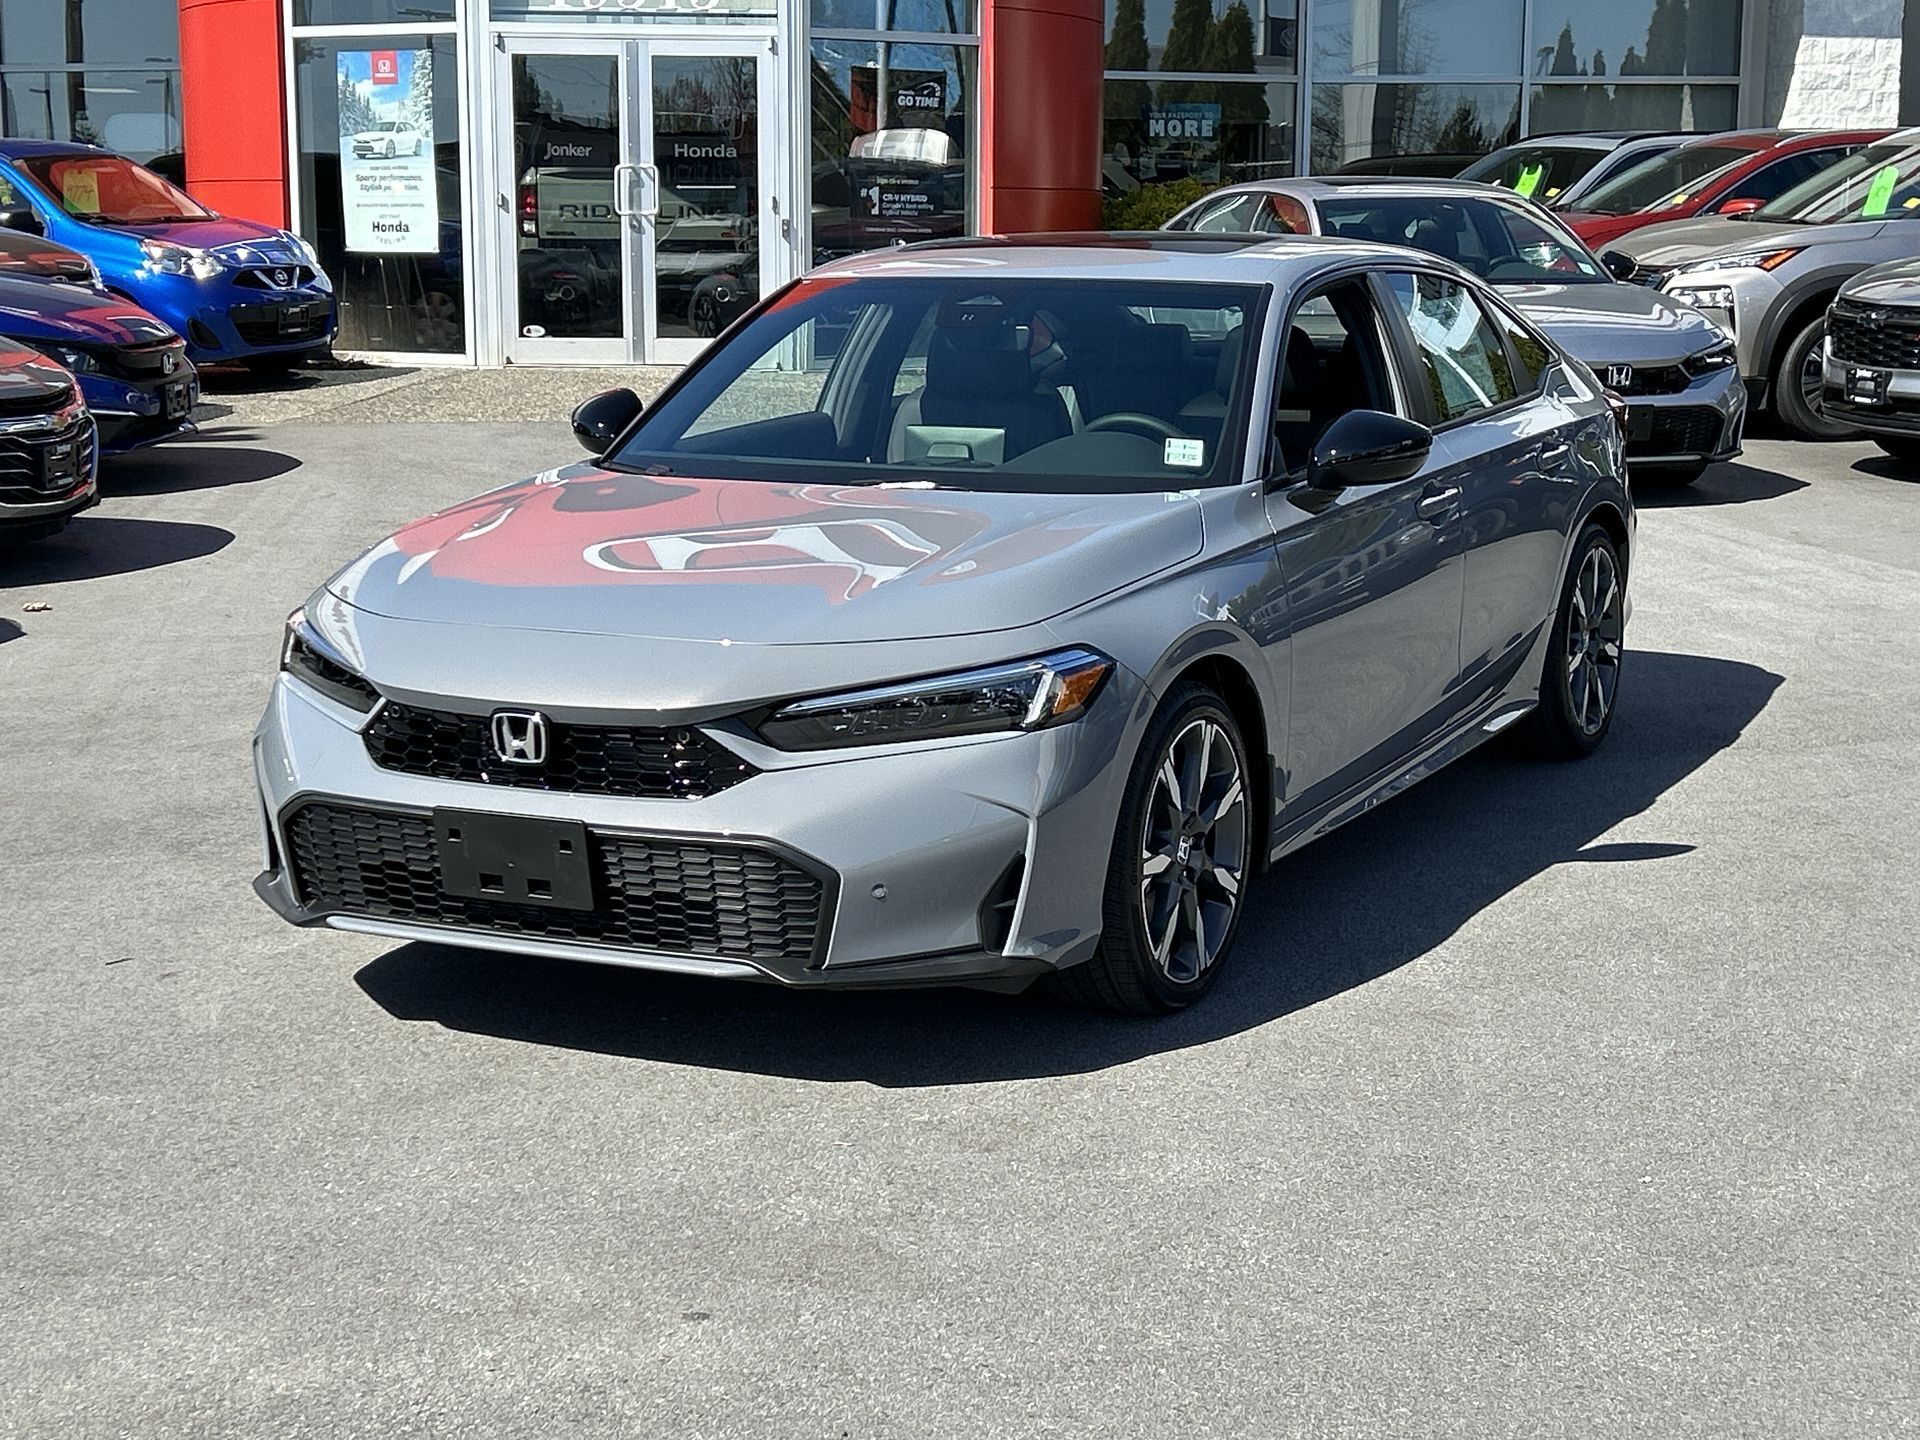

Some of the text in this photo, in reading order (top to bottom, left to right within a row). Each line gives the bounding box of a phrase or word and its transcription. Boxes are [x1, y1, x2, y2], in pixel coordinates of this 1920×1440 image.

[897, 95, 940, 107] GO TIME
[1149, 119, 1213, 137] MORE
[544, 142, 592, 160] Jonker
[674, 143, 737, 158] Honda
[372, 220, 410, 232] Honda
